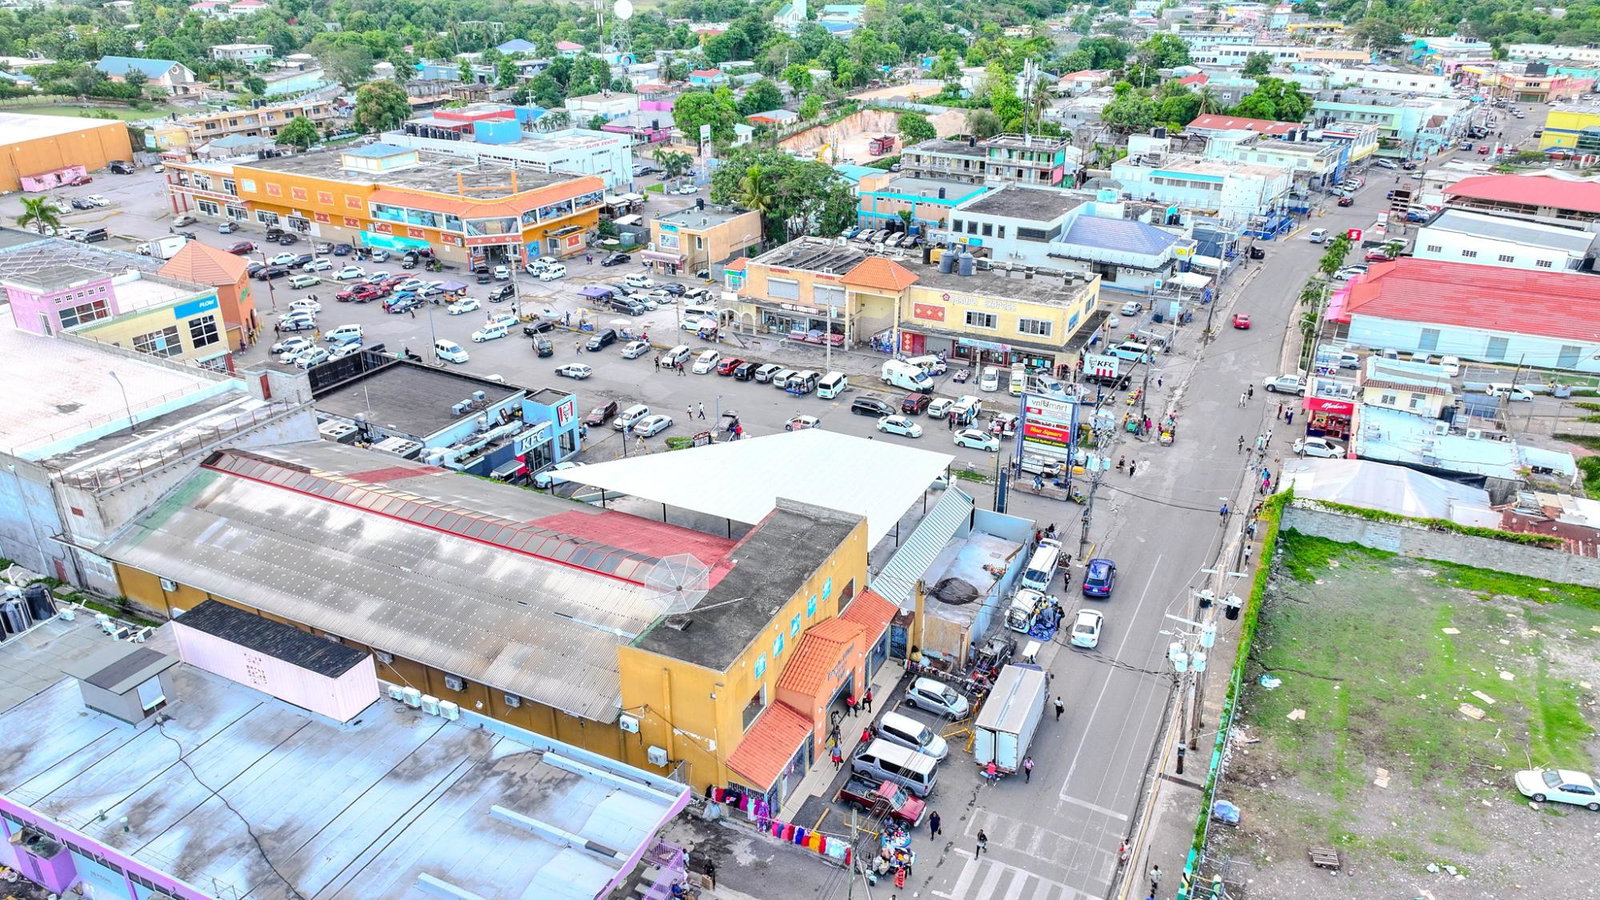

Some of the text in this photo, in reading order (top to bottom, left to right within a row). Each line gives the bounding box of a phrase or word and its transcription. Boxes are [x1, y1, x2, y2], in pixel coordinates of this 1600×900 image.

[199, 299, 215, 308] FLOW
[1097, 360, 1115, 368] KFC
[521, 429, 545, 452] KFC
